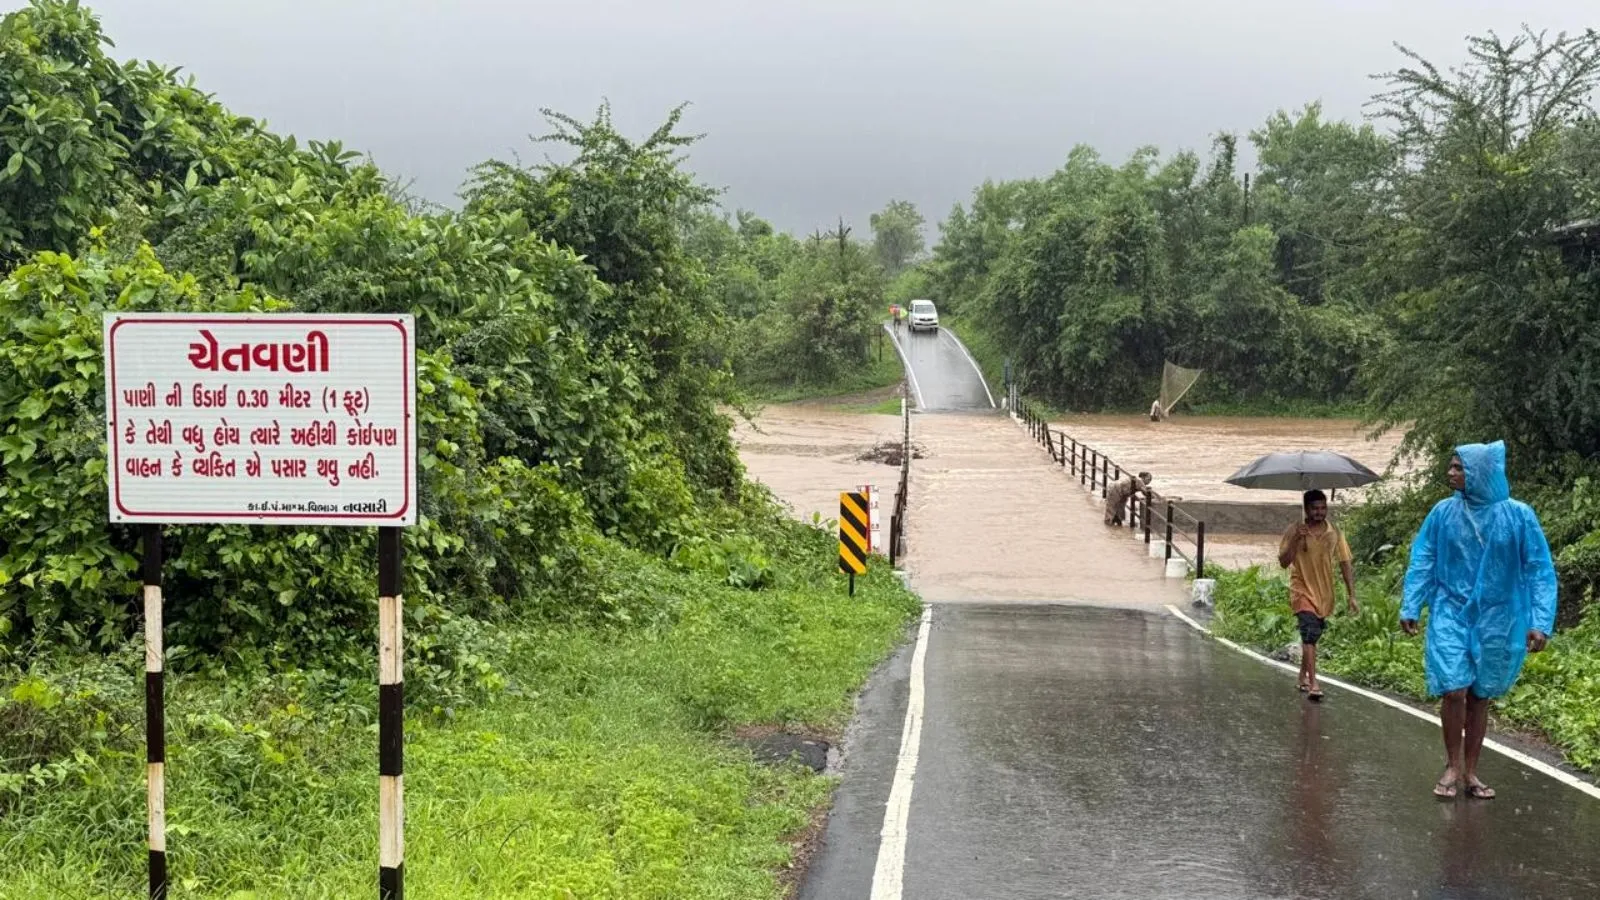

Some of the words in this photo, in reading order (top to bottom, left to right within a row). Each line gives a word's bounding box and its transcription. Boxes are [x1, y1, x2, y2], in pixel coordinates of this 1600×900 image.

[188, 330, 330, 373] ચેતવણી
[123, 382, 156, 408] પાણી
[165, 382, 182, 408] ની
[237, 389, 269, 408] 0.30
[278, 382, 312, 408] મીટર
[124, 418, 136, 444] કે
[145, 418, 173, 445] તેથી
[182, 424, 206, 453] વધુ
[213, 417, 240, 446] હોય
[250, 419, 281, 446] ત્યારે
[346, 418, 398, 446] કોઈપણ
[125, 457, 162, 478] વાહન
[171, 450, 182, 477] કે
[246, 450, 262, 477] એ
[271, 459, 307, 478] પસાર
[317, 458, 340, 486] થવુ
[343, 499, 387, 513] નવસારી
